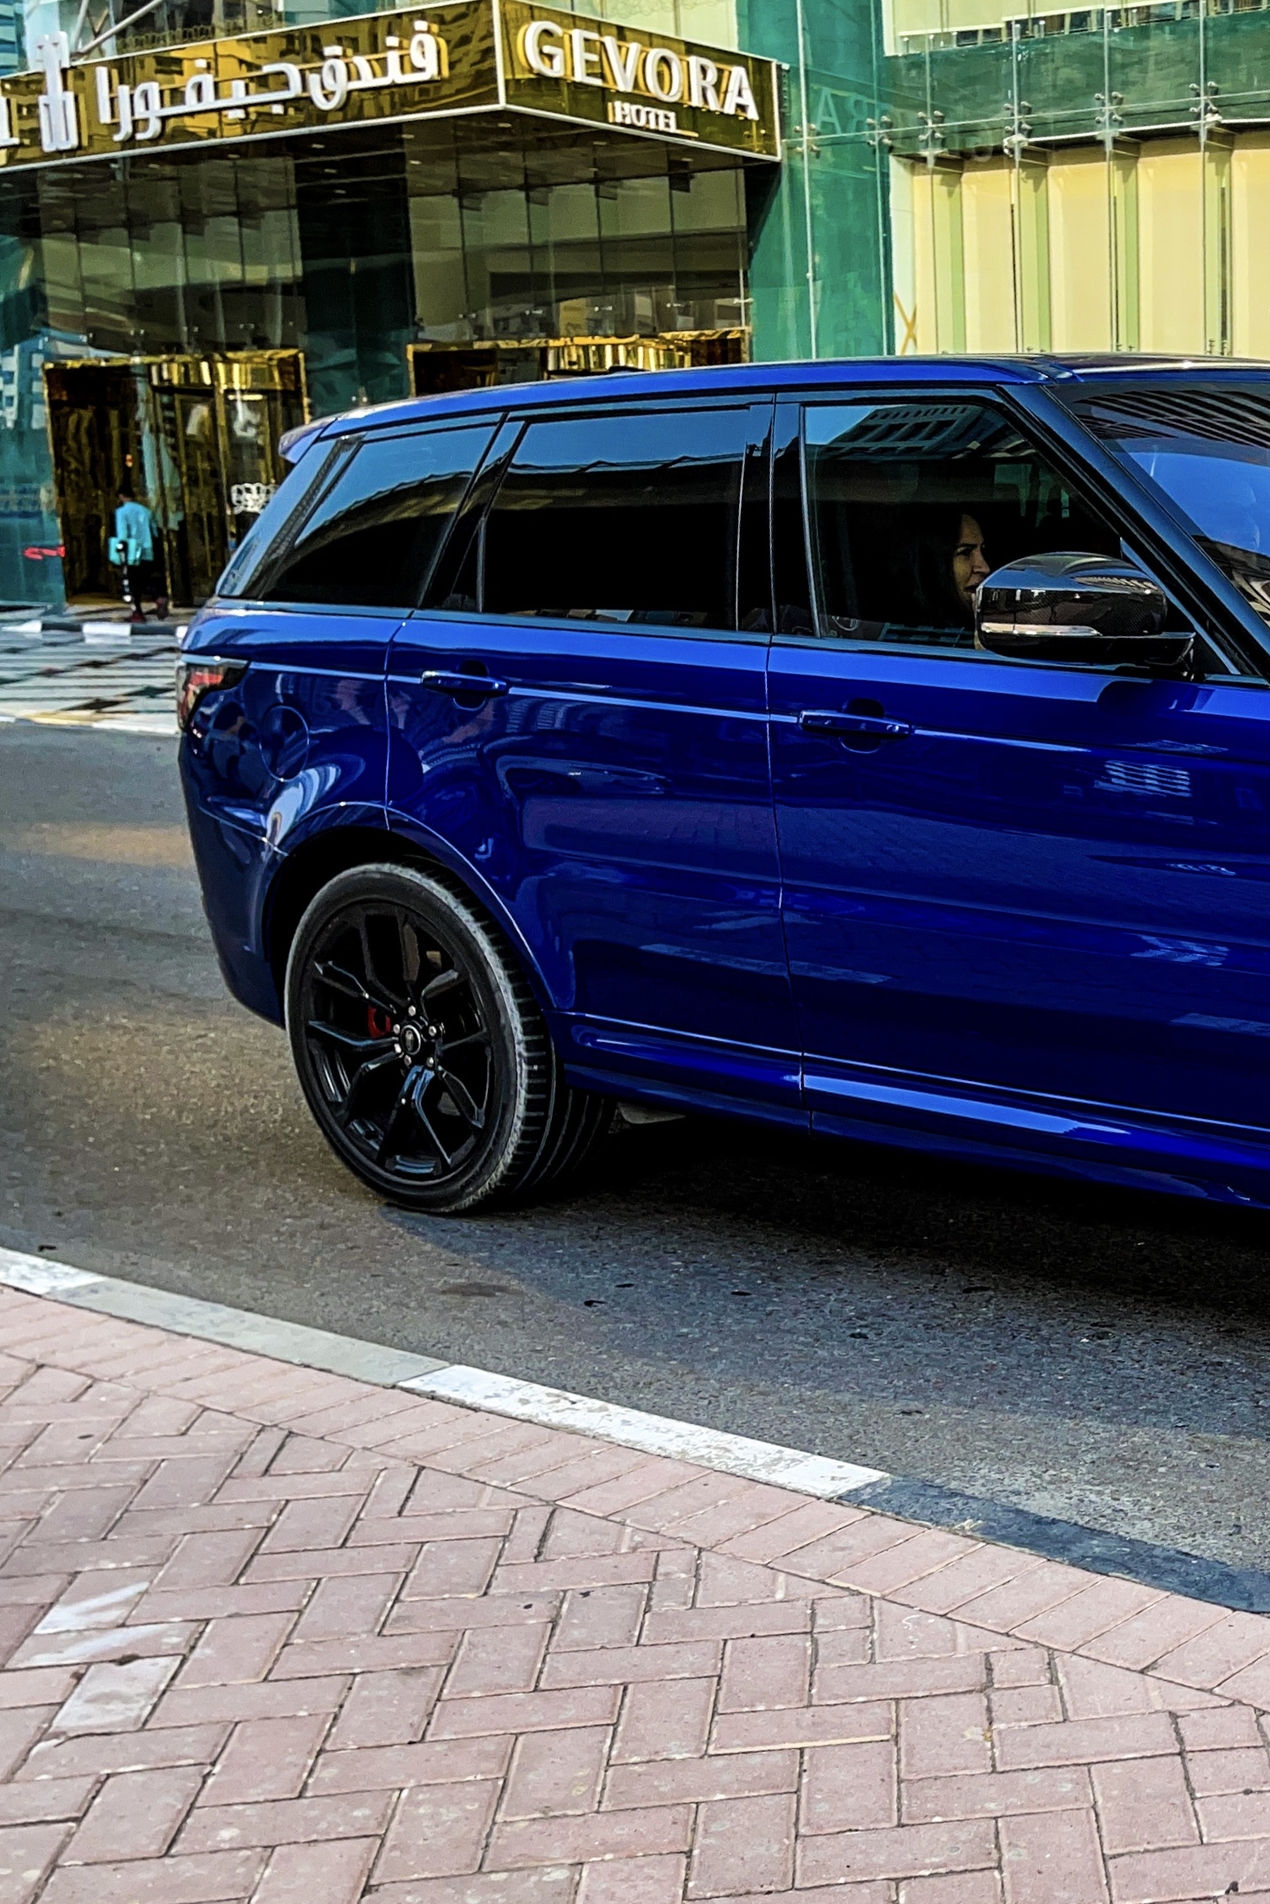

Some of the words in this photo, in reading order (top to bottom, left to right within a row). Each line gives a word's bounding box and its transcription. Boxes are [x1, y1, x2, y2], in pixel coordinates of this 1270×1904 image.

[95, 58, 301, 142] جيفورا
[308, 20, 439, 111] فندق
[524, 20, 759, 121] GEVORA
[614, 100, 678, 133] HOTEL
